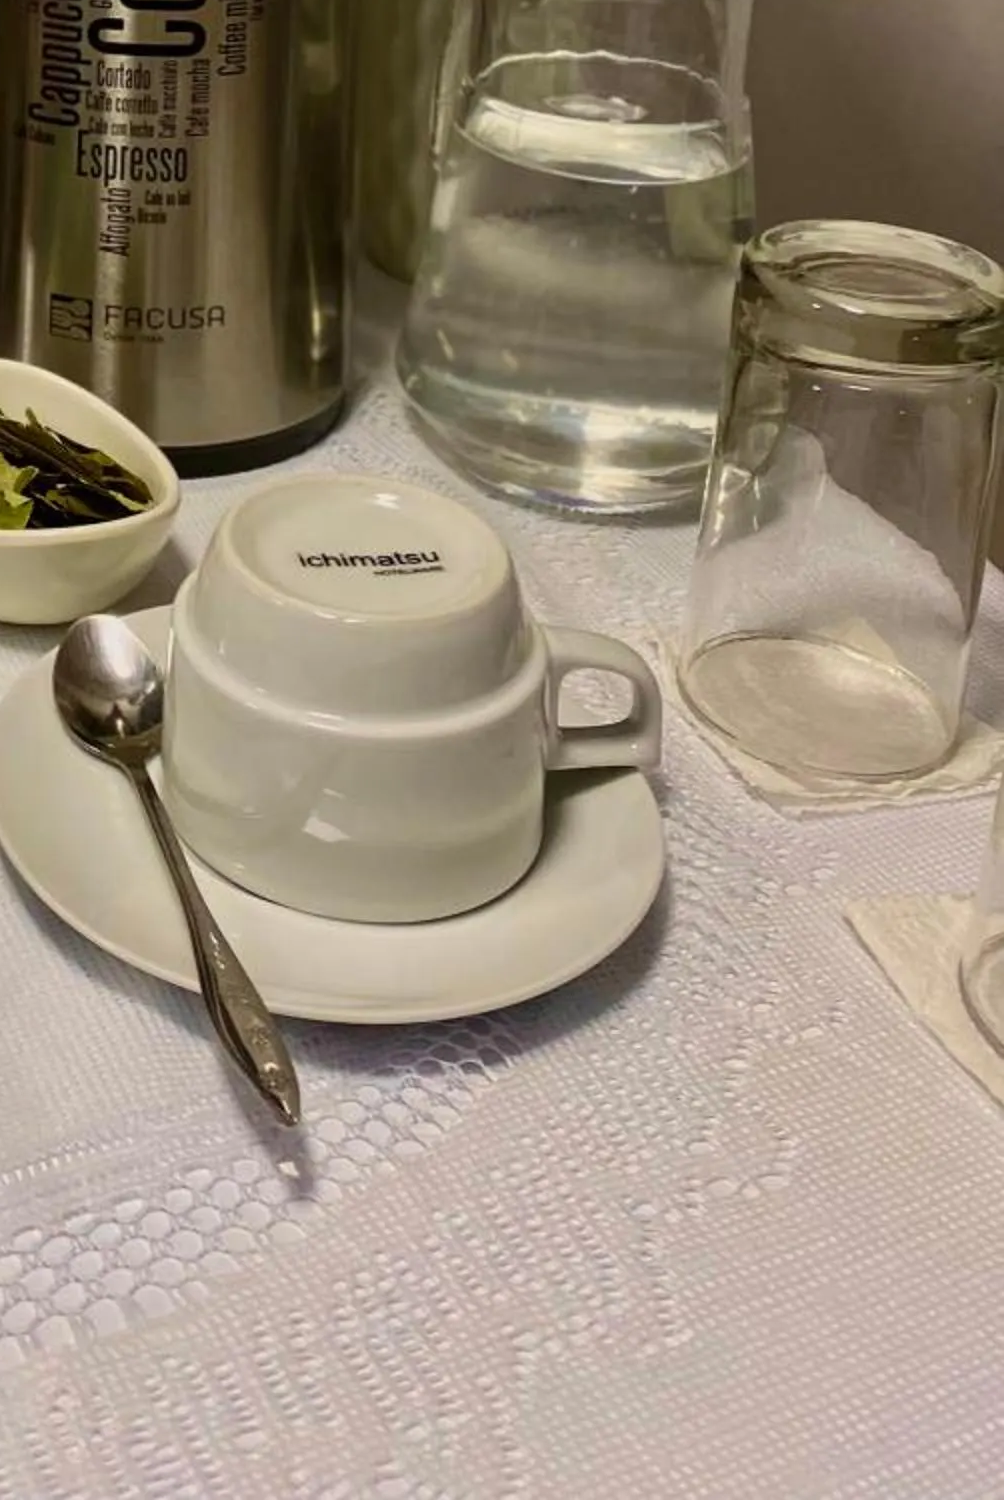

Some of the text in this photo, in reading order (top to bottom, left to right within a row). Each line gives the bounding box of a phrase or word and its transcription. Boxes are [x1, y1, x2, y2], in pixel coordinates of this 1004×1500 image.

[218, 21, 247, 77] Coffee
[97, 60, 151, 90] Cortado
[186, 58, 210, 106] mocha
[76, 129, 188, 187] Espresso
[100, 188, 136, 257] Affogato
[104, 304, 226, 330] FACUSA
[297, 550, 441, 568] ichimatsu
